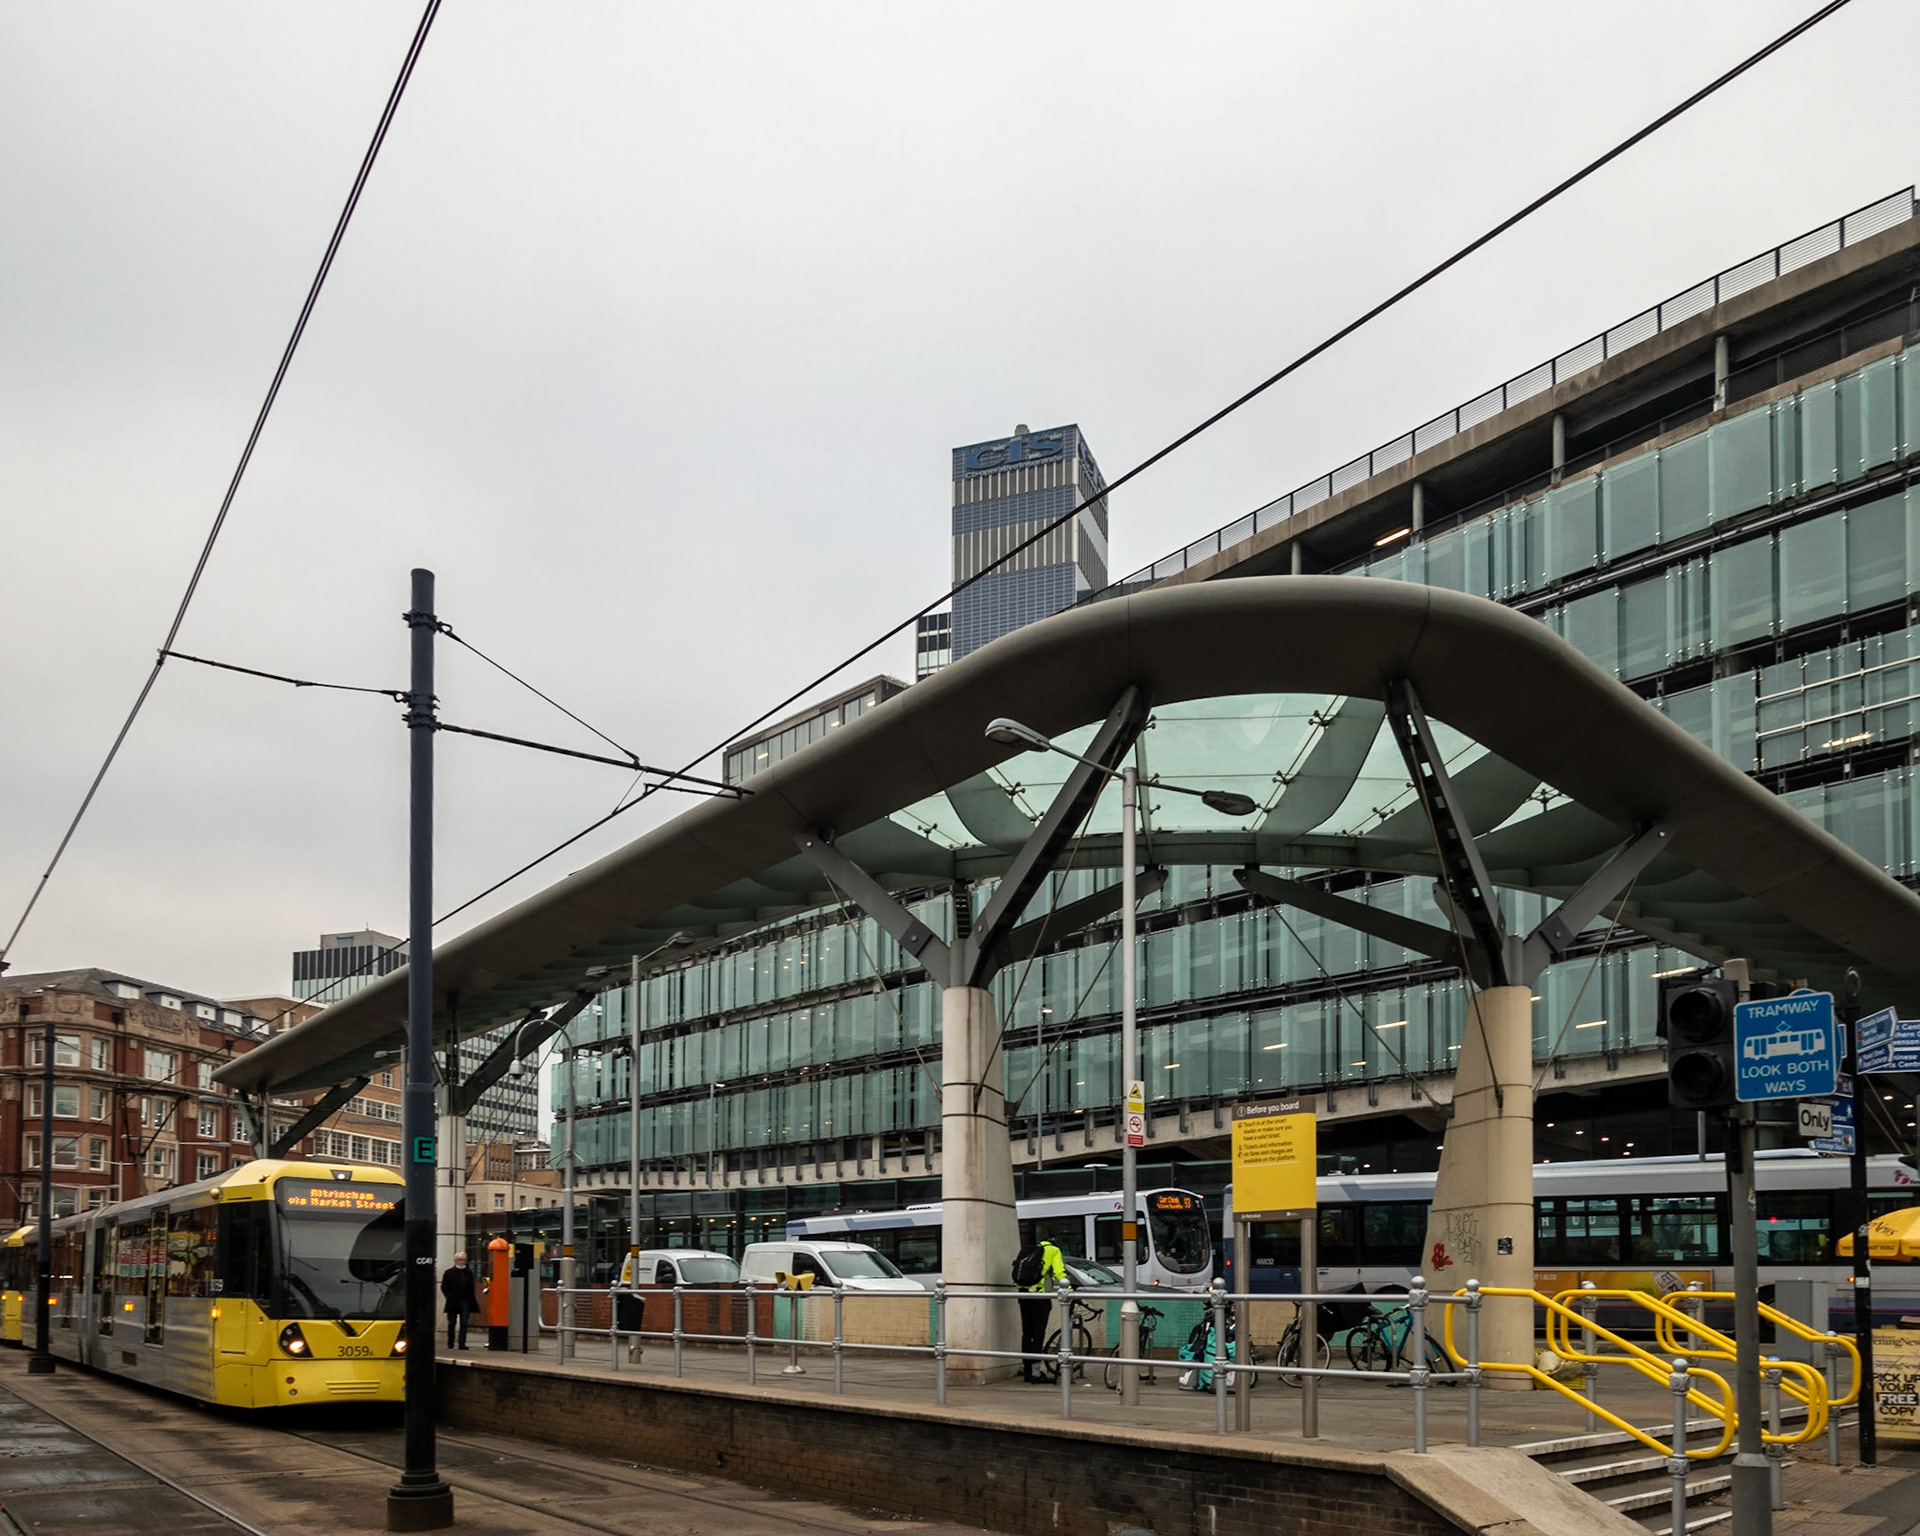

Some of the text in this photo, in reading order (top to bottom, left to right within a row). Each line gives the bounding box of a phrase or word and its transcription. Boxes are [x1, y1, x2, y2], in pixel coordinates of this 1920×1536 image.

[1747, 1000, 1819, 1018] TRAMWAY
[1742, 1060, 1829, 1079] LOOK BOTH
[1765, 1079, 1806, 1093] WAYS
[1247, 1101, 1299, 1114] Before you board
[1801, 1110, 1829, 1132] Only
[418, 1140, 432, 1159] E
[310, 1188, 374, 1201] Altrincham
[288, 1196, 395, 1209] via Market Street
[1873, 1373, 1920, 1384] PICK UP
[1879, 1382, 1916, 1394] YOUR
[1878, 1393, 1917, 1405] FREE
[1880, 1406, 1916, 1416] COPY
